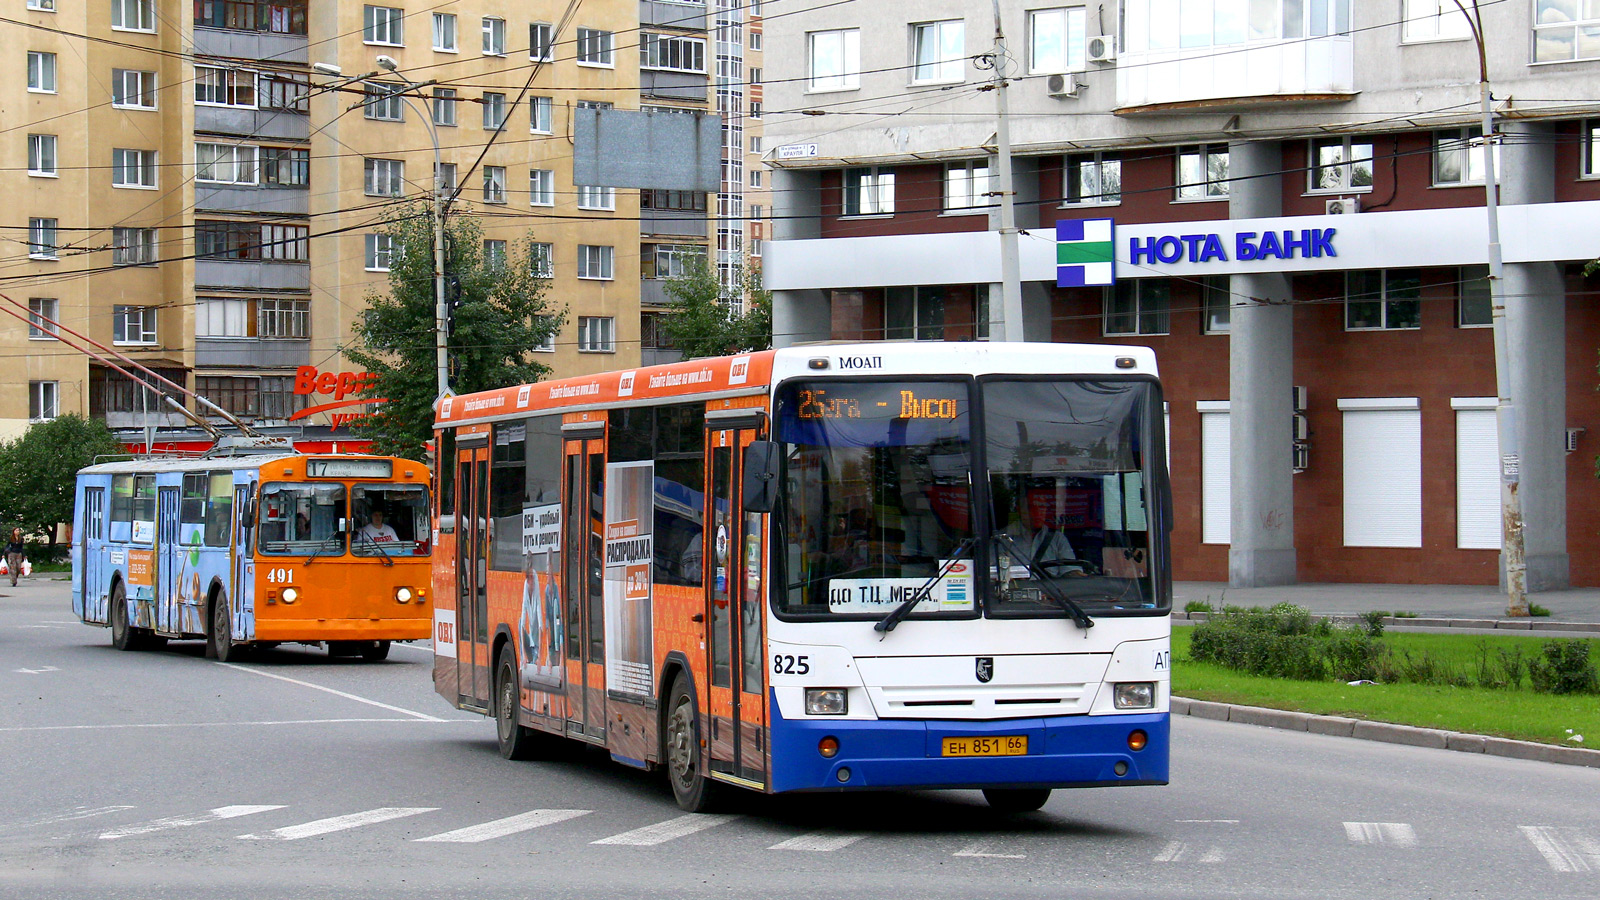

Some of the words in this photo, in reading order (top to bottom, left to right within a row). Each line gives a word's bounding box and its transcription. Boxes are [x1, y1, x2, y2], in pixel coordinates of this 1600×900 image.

[810, 145, 816, 155] 2
[1129, 233, 1228, 265] НОТА
[1235, 227, 1337, 261] БАНК
[731, 362, 747, 378] OBI
[839, 356, 882, 370] МОАП
[621, 377, 633, 390] OBI
[311, 461, 328, 476] 17
[524, 513, 535, 529] ОБИ
[539, 509, 560, 529] удобный
[524, 534, 534, 550] путь
[539, 531, 560, 549] ремонту
[606, 538, 651, 564] РАСПРОДАЖА
[266, 568, 293, 584] 491
[626, 575, 635, 595] до
[634, 571, 648, 591] 30%
[830, 588, 852, 606] ДО
[438, 621, 454, 645] OBI
[774, 654, 810, 675] 825
[949, 742, 967, 754] ЕН
[973, 739, 1000, 753] 851
[1007, 737, 1023, 749] 66
